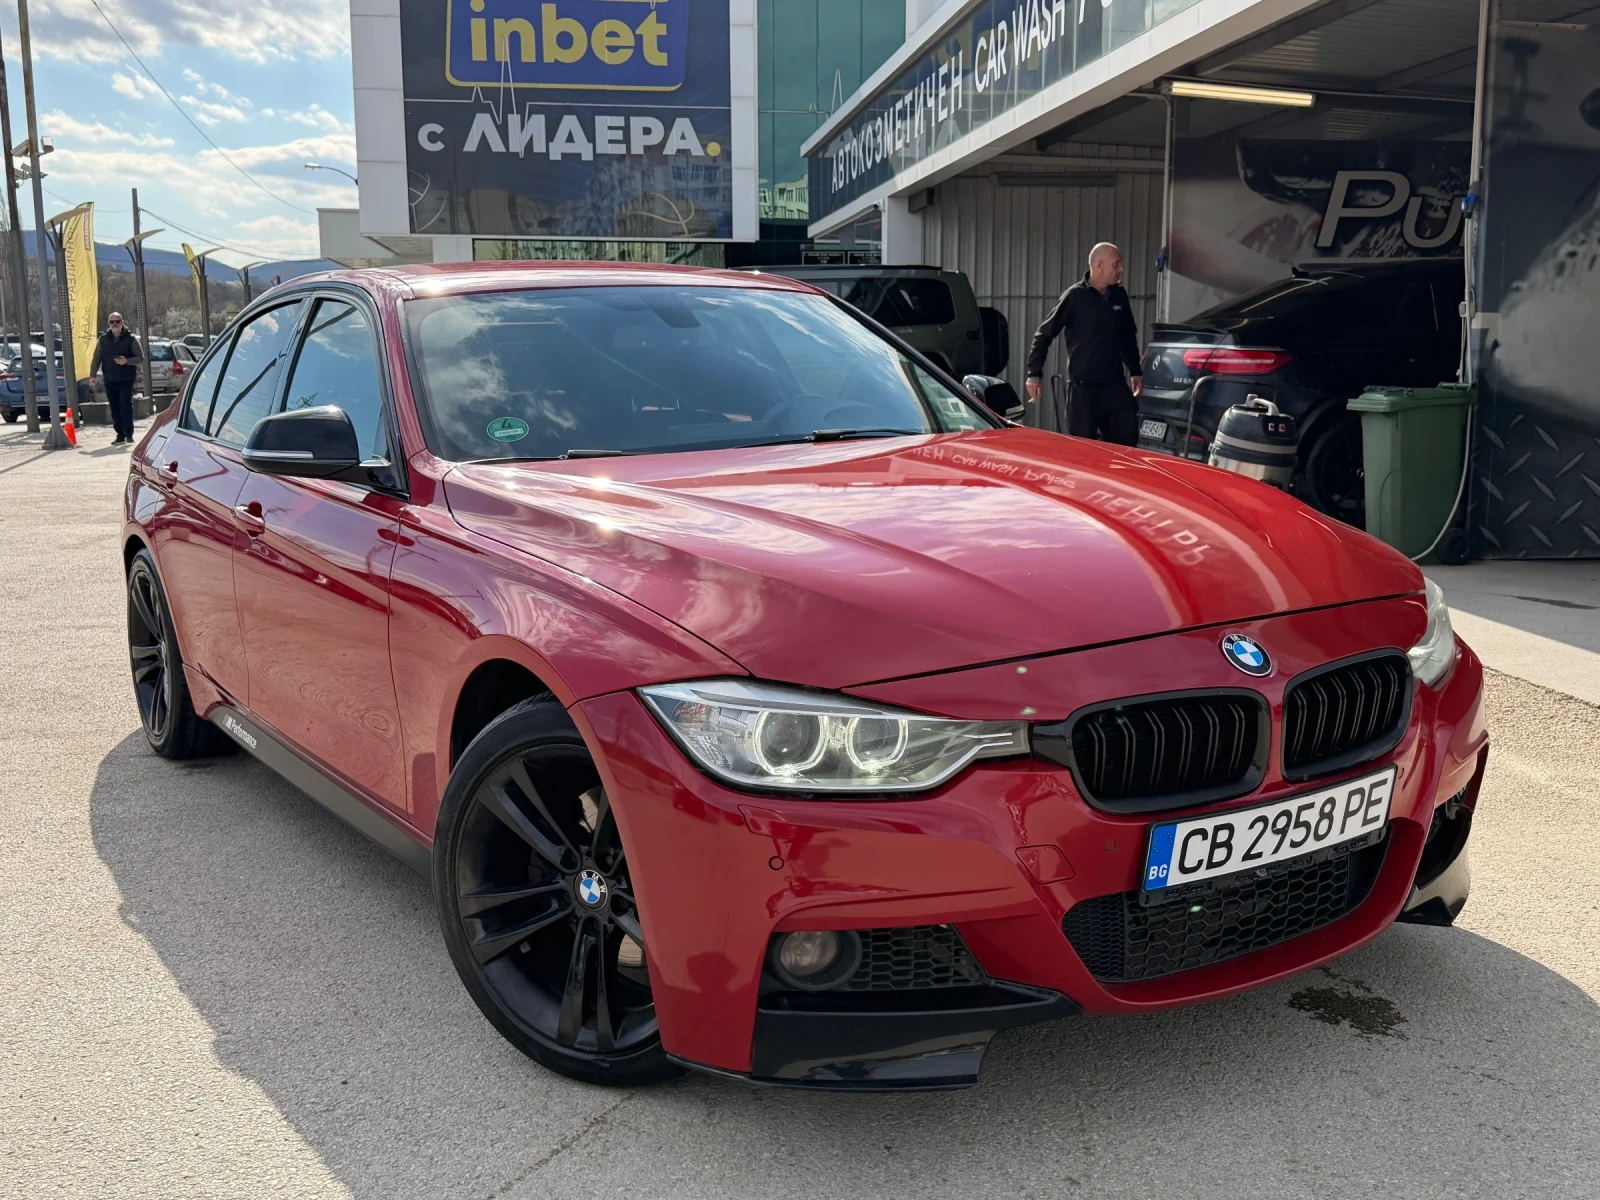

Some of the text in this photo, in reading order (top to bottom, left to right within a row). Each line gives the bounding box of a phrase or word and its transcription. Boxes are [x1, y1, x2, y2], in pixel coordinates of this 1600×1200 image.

[470, 0, 668, 66] inbet
[832, 0, 1065, 193] АВТОКОЗМЕТИЧЕН CAR WASH
[418, 113, 721, 161] с ЛИДЕРА.
[1316, 170, 1464, 248] Pu
[81, 306, 90, 334] Pulse
[1224, 634, 1255, 650] BMW
[231, 719, 257, 749] Performance
[1178, 777, 1388, 875] CB 2958 PE
[581, 871, 607, 893] BMW
[1149, 864, 1168, 880] BG
